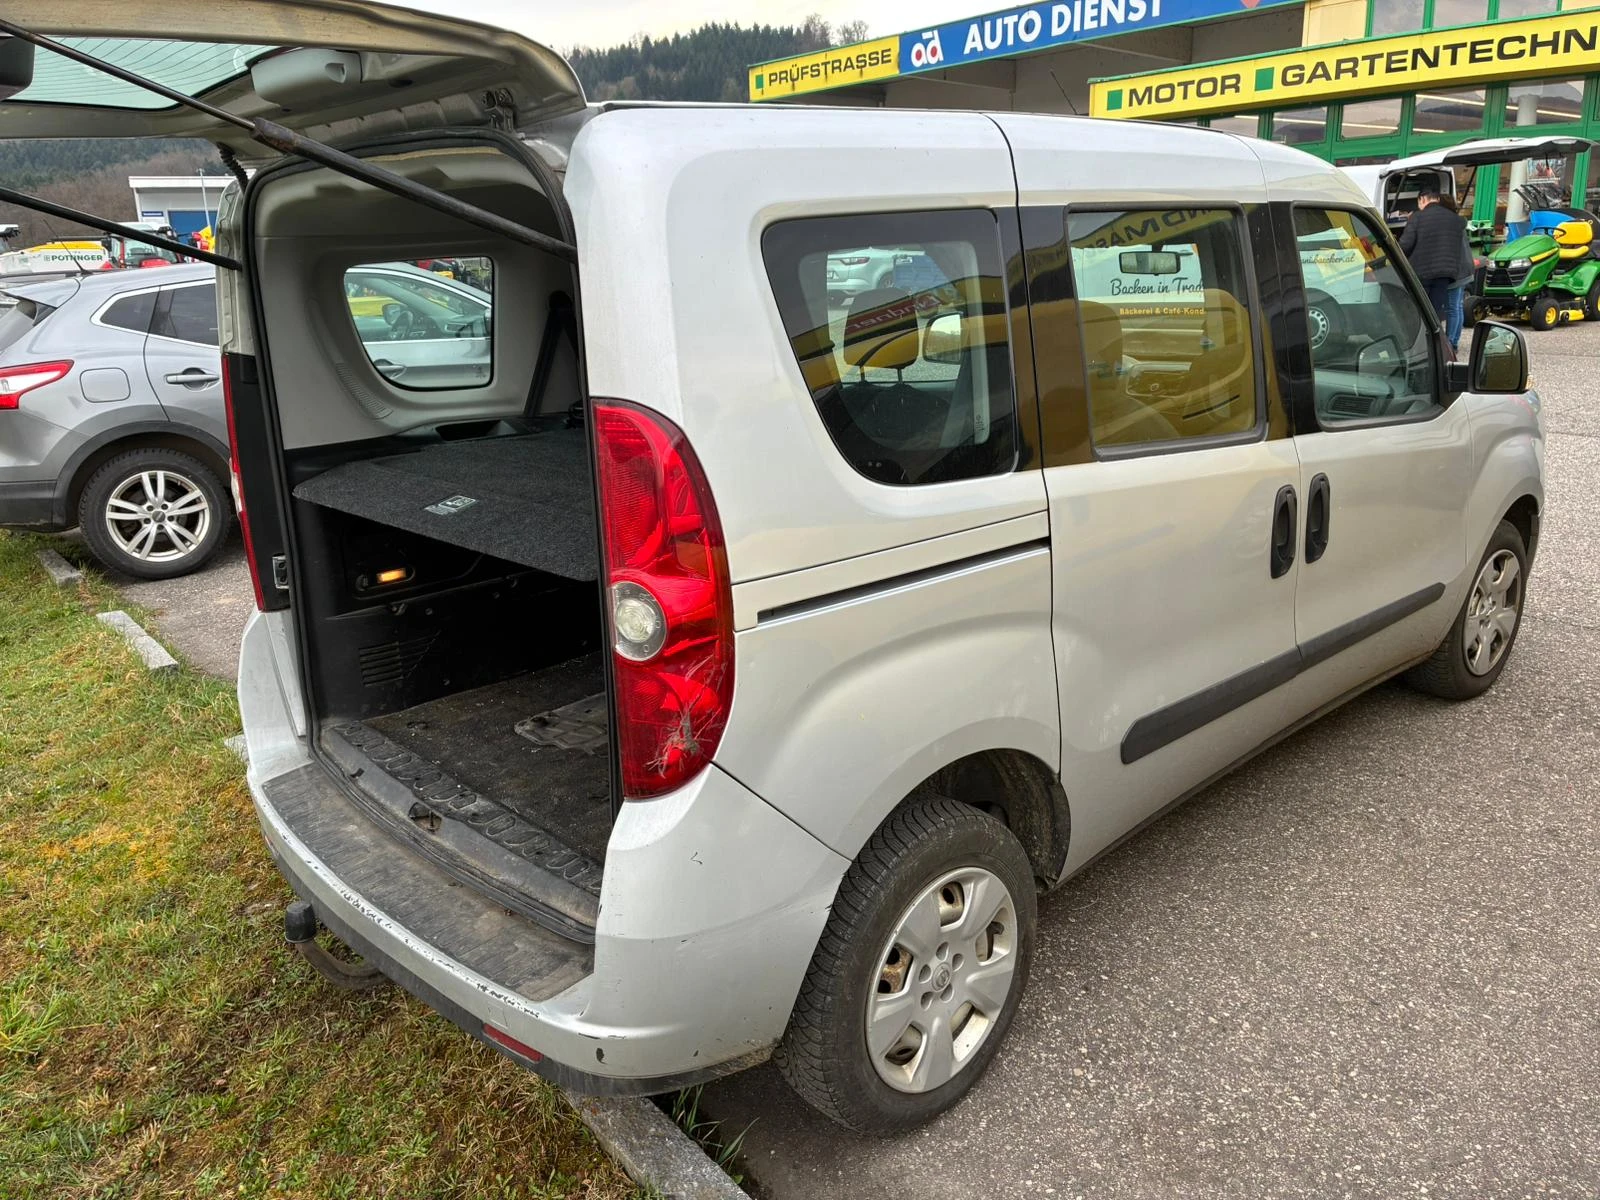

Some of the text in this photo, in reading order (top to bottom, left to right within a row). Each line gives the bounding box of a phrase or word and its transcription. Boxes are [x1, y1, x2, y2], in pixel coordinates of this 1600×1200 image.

[963, 9, 1042, 55] AUTO
[1050, 0, 1162, 37] DIENST
[768, 48, 892, 86] PRÜFSTRASSE
[1280, 25, 1598, 87] GARTENTECHN
[1128, 73, 1241, 107] MOTOR
[1110, 277, 1153, 296] Backen
[1157, 281, 1170, 294] in
[1119, 307, 1153, 315] Bäckerei
